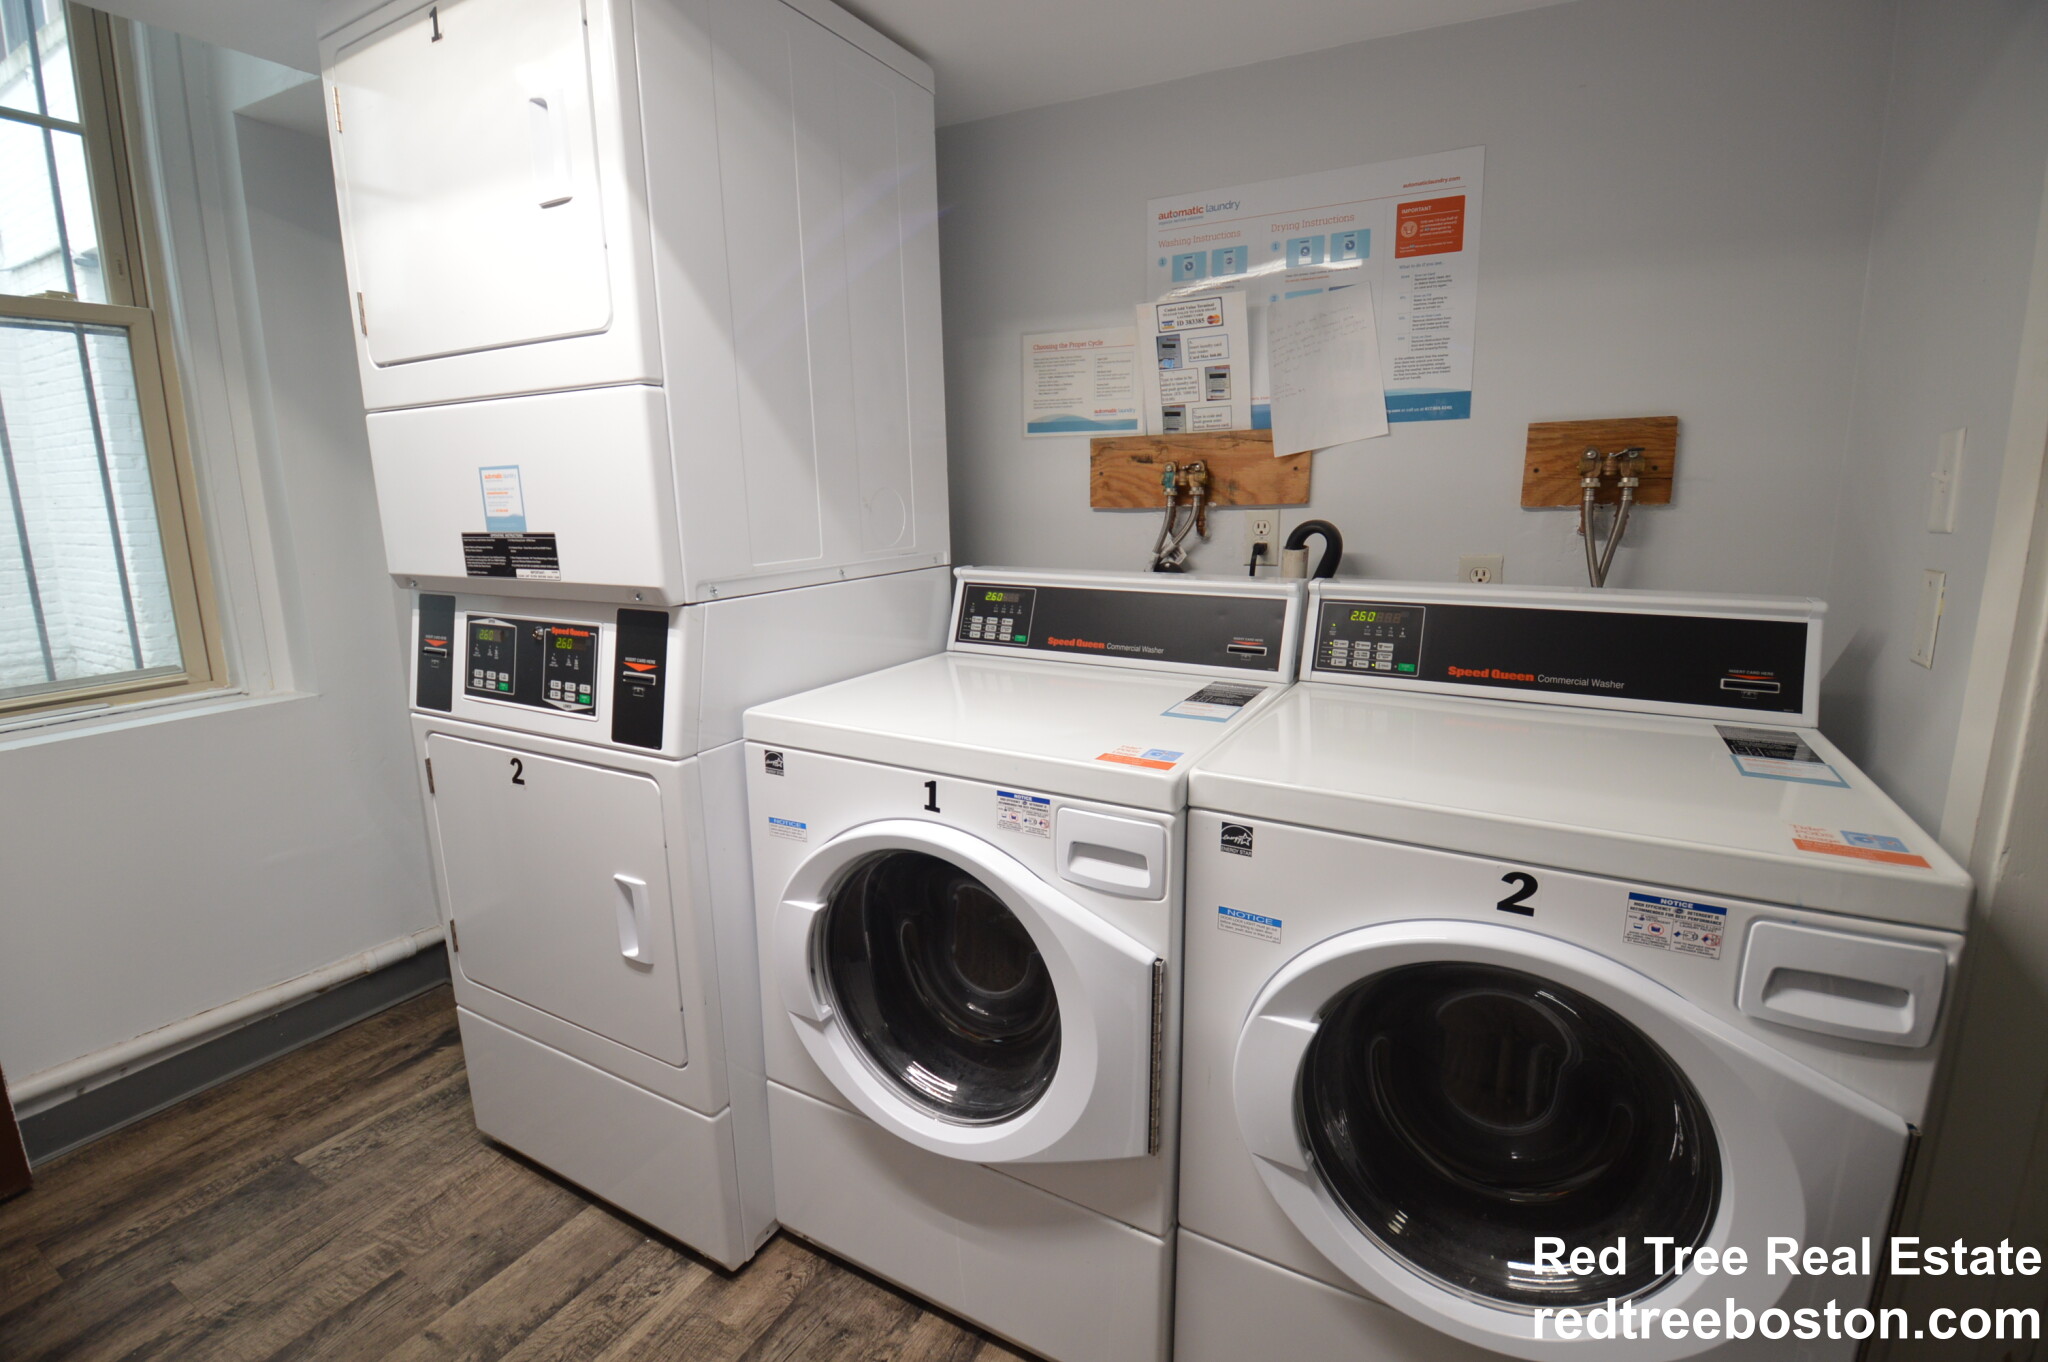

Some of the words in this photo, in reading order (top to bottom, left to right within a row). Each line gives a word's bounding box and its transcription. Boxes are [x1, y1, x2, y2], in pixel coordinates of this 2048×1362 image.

[429, 6, 442, 43] 1
[1158, 206, 1204, 221] automatic
[1206, 201, 1240, 213] laundry
[1401, 205, 1432, 214] IMPORTANT
[1271, 222, 1300, 233] Drying
[1302, 214, 1355, 228] Instructions
[1158, 236, 1192, 248] Washing
[1194, 231, 1241, 243] Instructions
[1350, 610, 1376, 622] 2.60
[551, 626, 569, 636] Speed
[1048, 637, 1075, 646] Speed
[1076, 639, 1106, 649] Queen
[1107, 643, 1140, 652] Commercial
[1142, 646, 1164, 654] Washer
[1448, 666, 1489, 678] Speed
[1491, 669, 1534, 681] Queen
[1538, 674, 1589, 686] Commercial
[1591, 679, 1625, 689] Washer
[510, 758, 525, 785] 2
[924, 780, 940, 814] 1
[773, 818, 801, 828] NOTICE
[1221, 845, 1240, 854] ENERGY
[1240, 849, 1252, 857] STAR
[1497, 872, 1538, 917] 2
[1660, 899, 1693, 908] NOTICE
[1227, 909, 1273, 925] NOTICE
[1630, 906, 1664, 915] RECOMMENDED
[1688, 917, 1721, 925] PERFORMANCE
